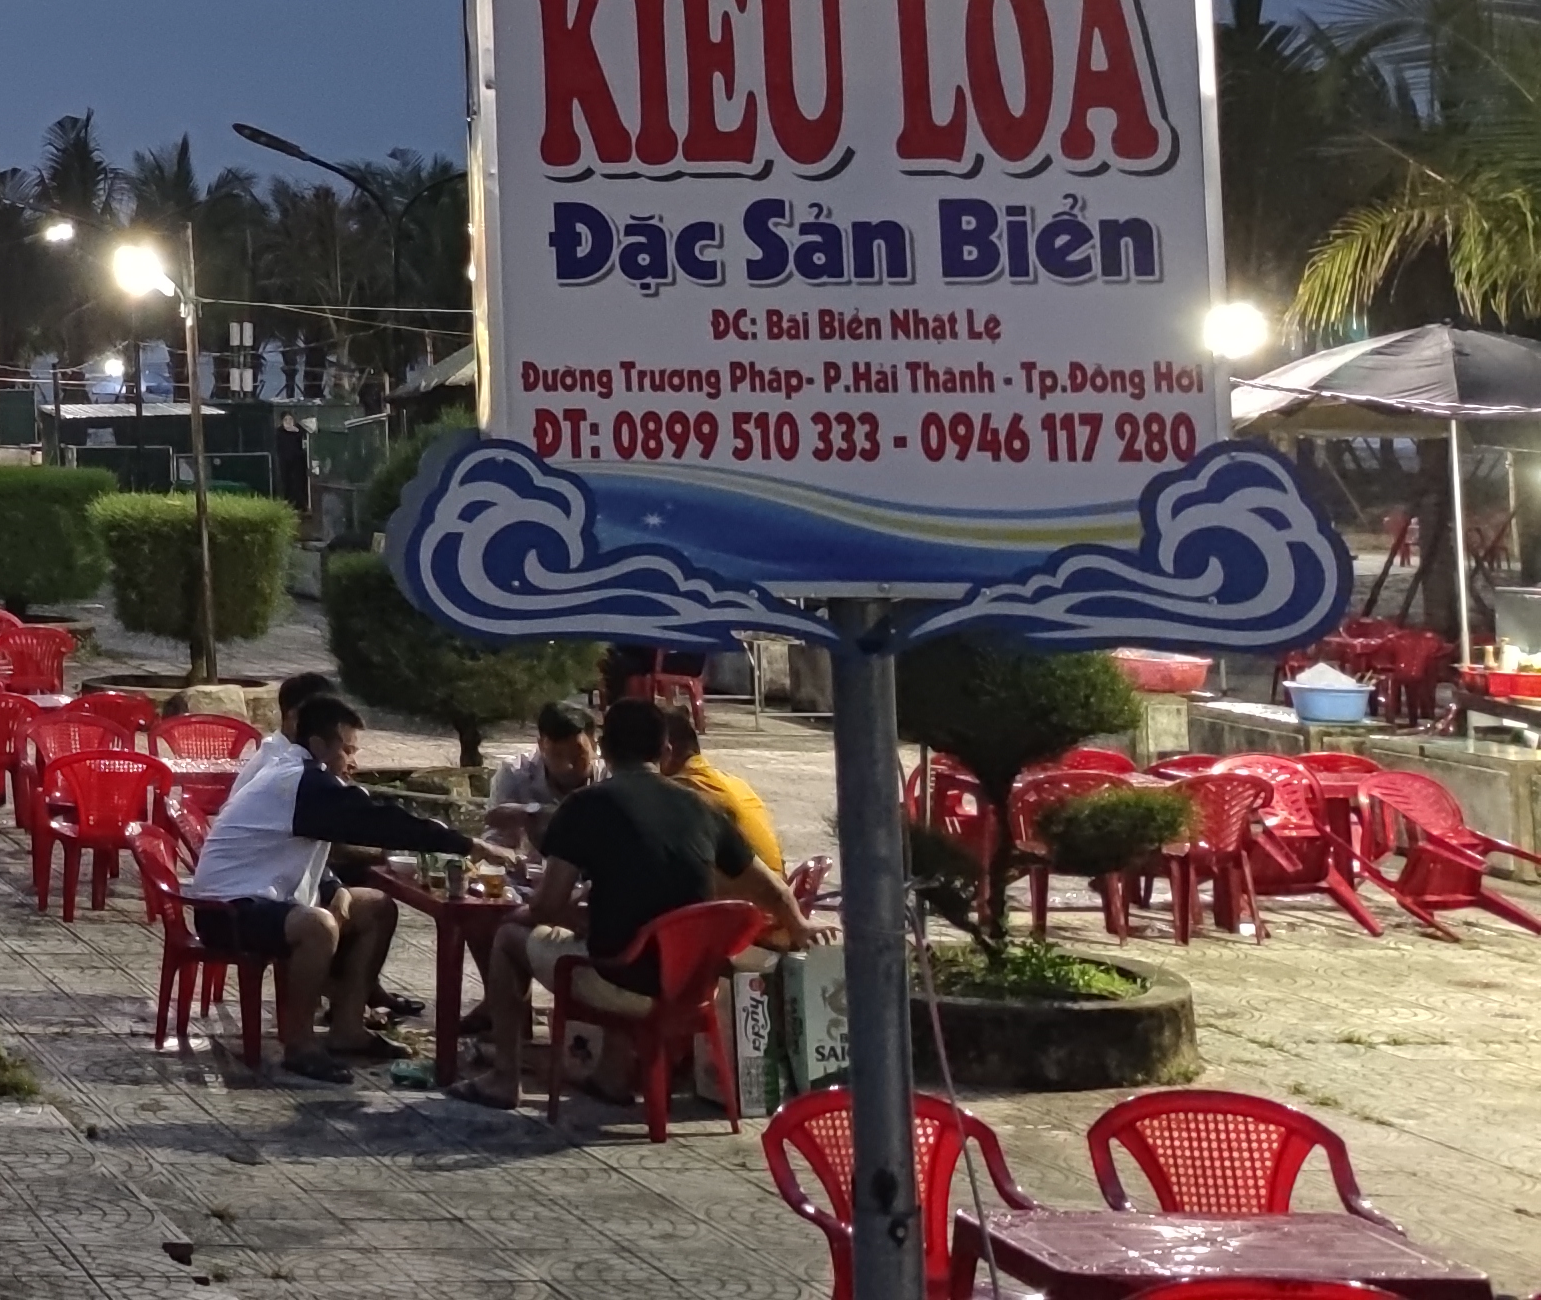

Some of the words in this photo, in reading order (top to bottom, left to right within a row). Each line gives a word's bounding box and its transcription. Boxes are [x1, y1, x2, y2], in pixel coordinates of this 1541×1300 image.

[548, 201, 721, 292] Đặc
[742, 198, 910, 284] Sản
[938, 193, 1160, 284] Biển
[710, 308, 757, 341] ĐC:
[766, 308, 810, 341] Bãi
[818, 307, 882, 341] Biển
[889, 308, 959, 345] Nhật
[966, 308, 1002, 345] Lệ
[520, 360, 614, 400] Đường
[620, 360, 722, 400] Trương
[823, 360, 899, 394] P.Hải
[905, 360, 996, 394] Thành
[1019, 360, 1146, 401] Tp.Đồng
[533, 408, 602, 460] ĐT:
[613, 410, 720, 461] 0899
[731, 411, 801, 462] 510
[810, 411, 881, 463] 333
[893, 435, 908, 449] -
[920, 411, 1031, 463] 0946
[1040, 412, 1104, 463] 117
[1114, 411, 1197, 463] 280
[815, 1045, 850, 1062] SAI
